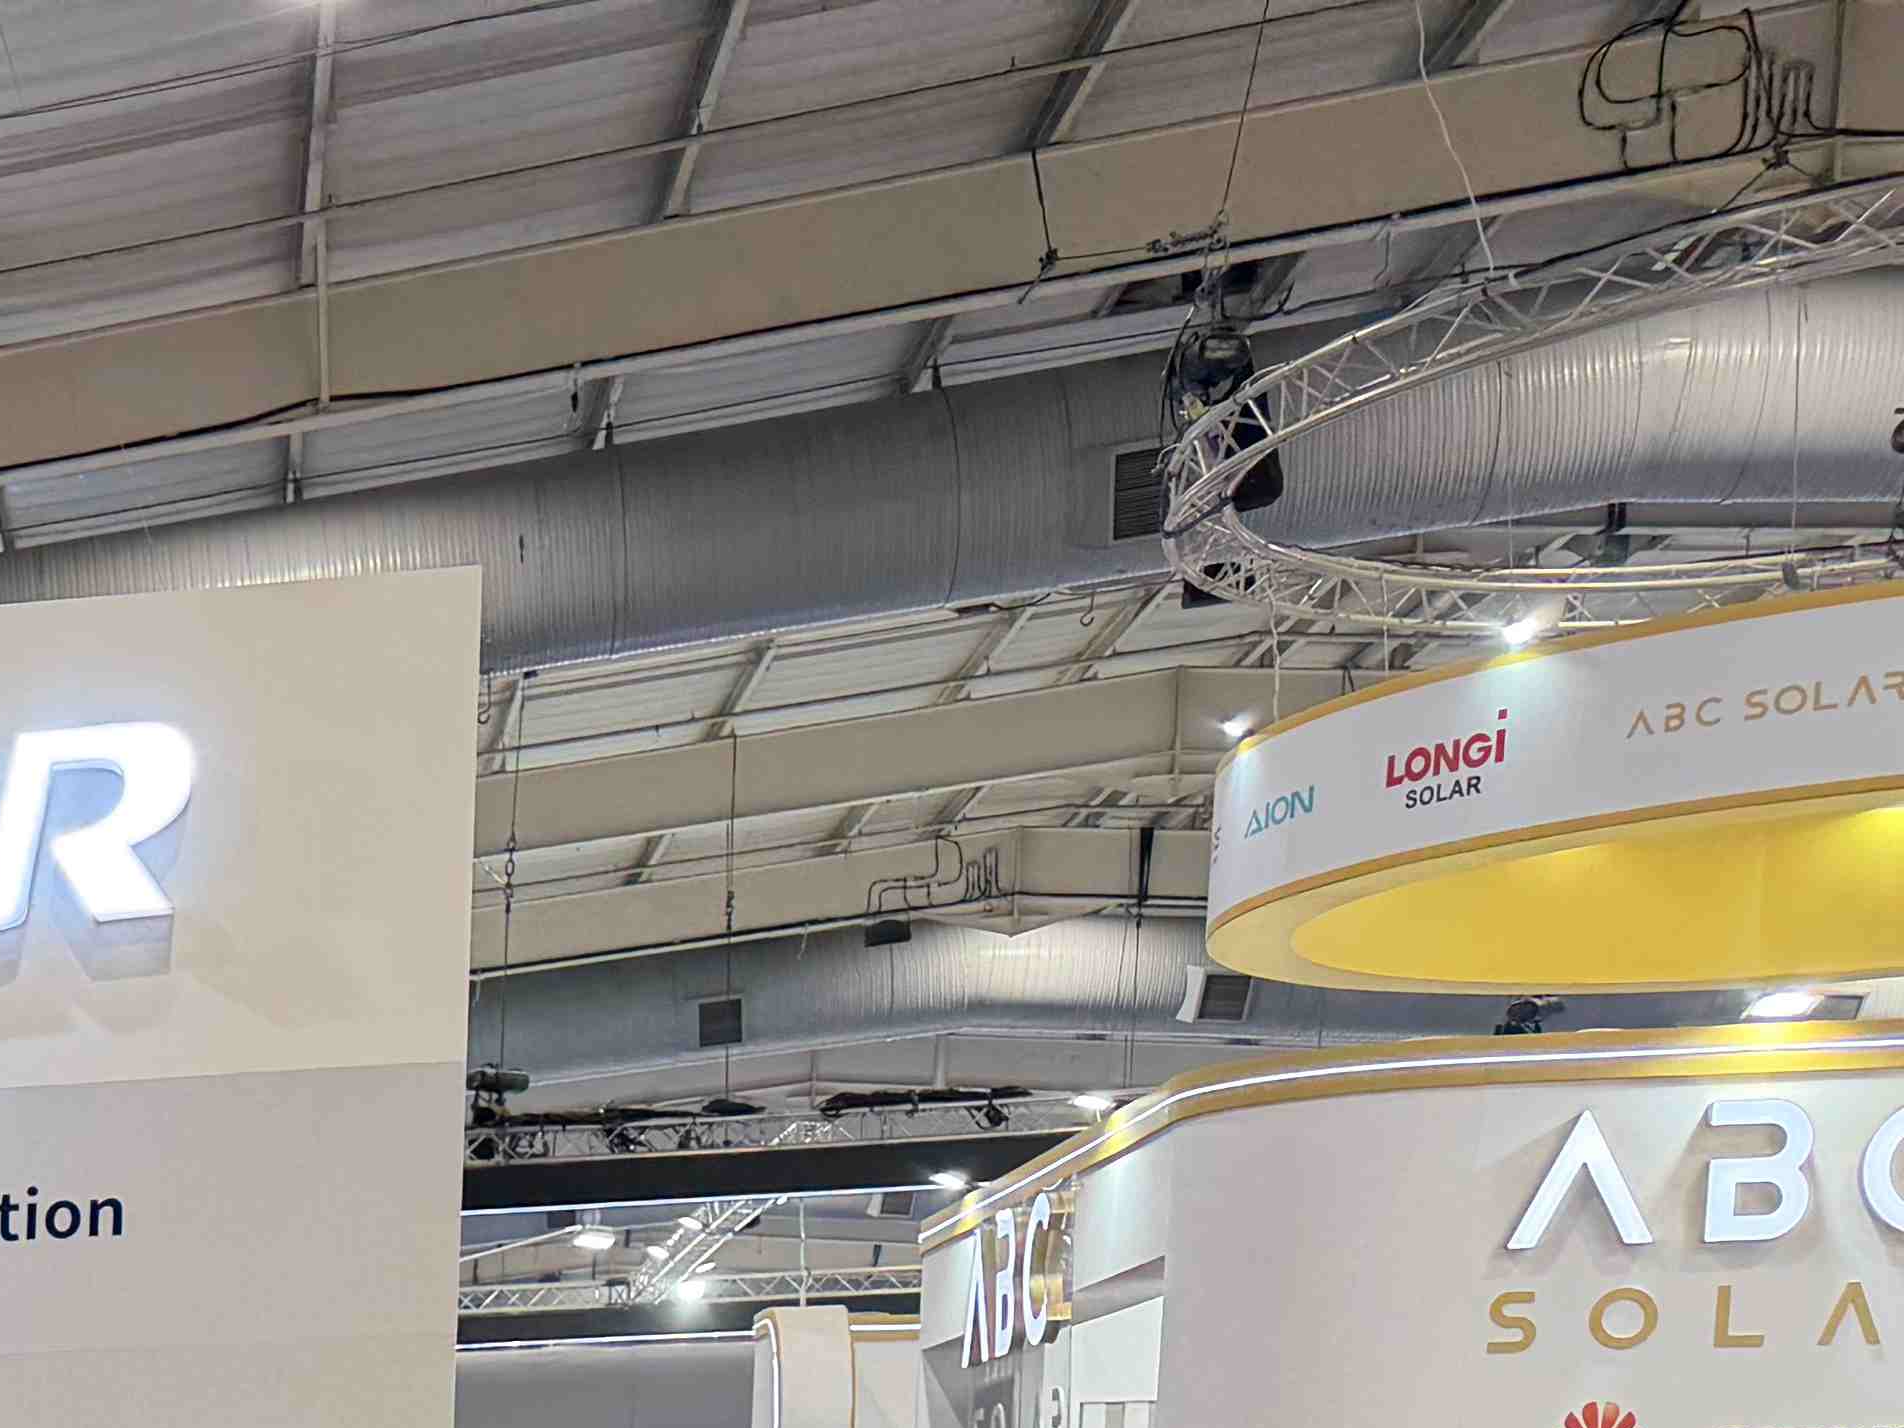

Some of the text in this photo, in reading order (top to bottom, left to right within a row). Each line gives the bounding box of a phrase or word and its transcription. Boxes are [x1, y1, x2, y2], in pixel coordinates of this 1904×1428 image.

[1626, 697, 1724, 739] ABC
[1244, 785, 1314, 839] AION
[1405, 775, 1482, 809] SOLAR
[961, 1193, 1050, 1369] ABC
[1486, 1281, 1881, 1355] SOLA
